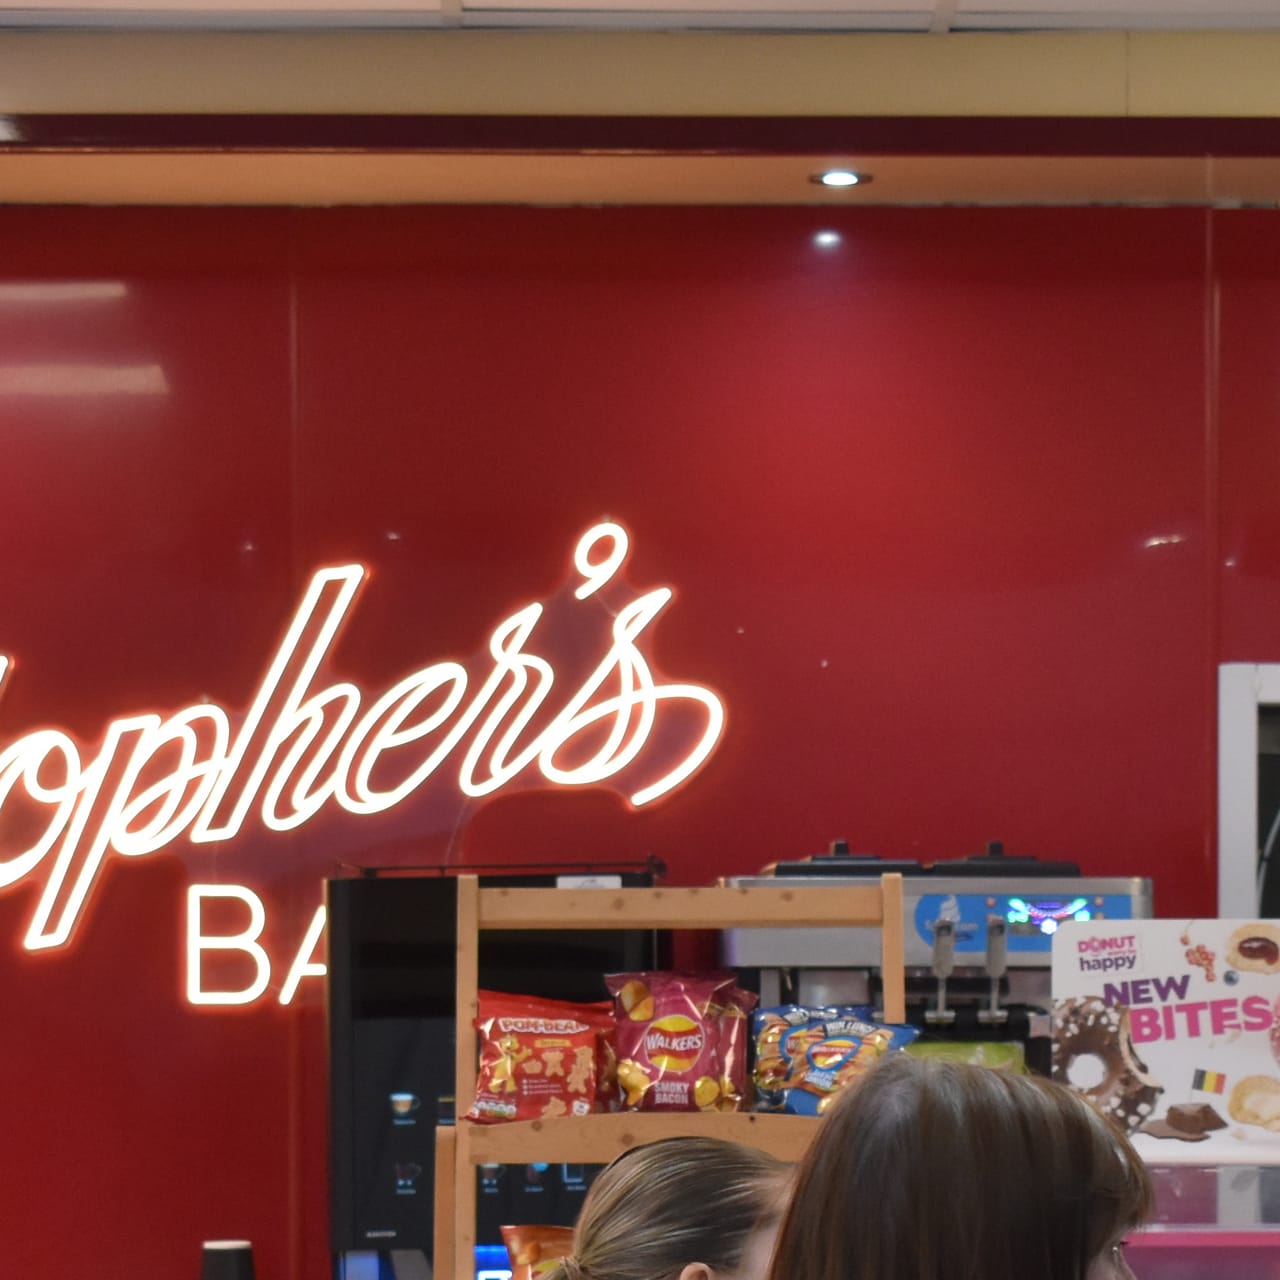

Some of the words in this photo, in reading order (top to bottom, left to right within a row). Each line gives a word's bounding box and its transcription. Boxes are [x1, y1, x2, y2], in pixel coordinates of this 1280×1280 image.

[1078, 934, 1136, 953] DONUT
[1079, 954, 1136, 972] happy
[1103, 974, 1191, 1008] NEW
[1128, 995, 1274, 1044] BITES
[645, 1033, 702, 1051] WALKERS
[654, 1082, 690, 1094] SMOKY
[654, 1093, 690, 1105] BACON
